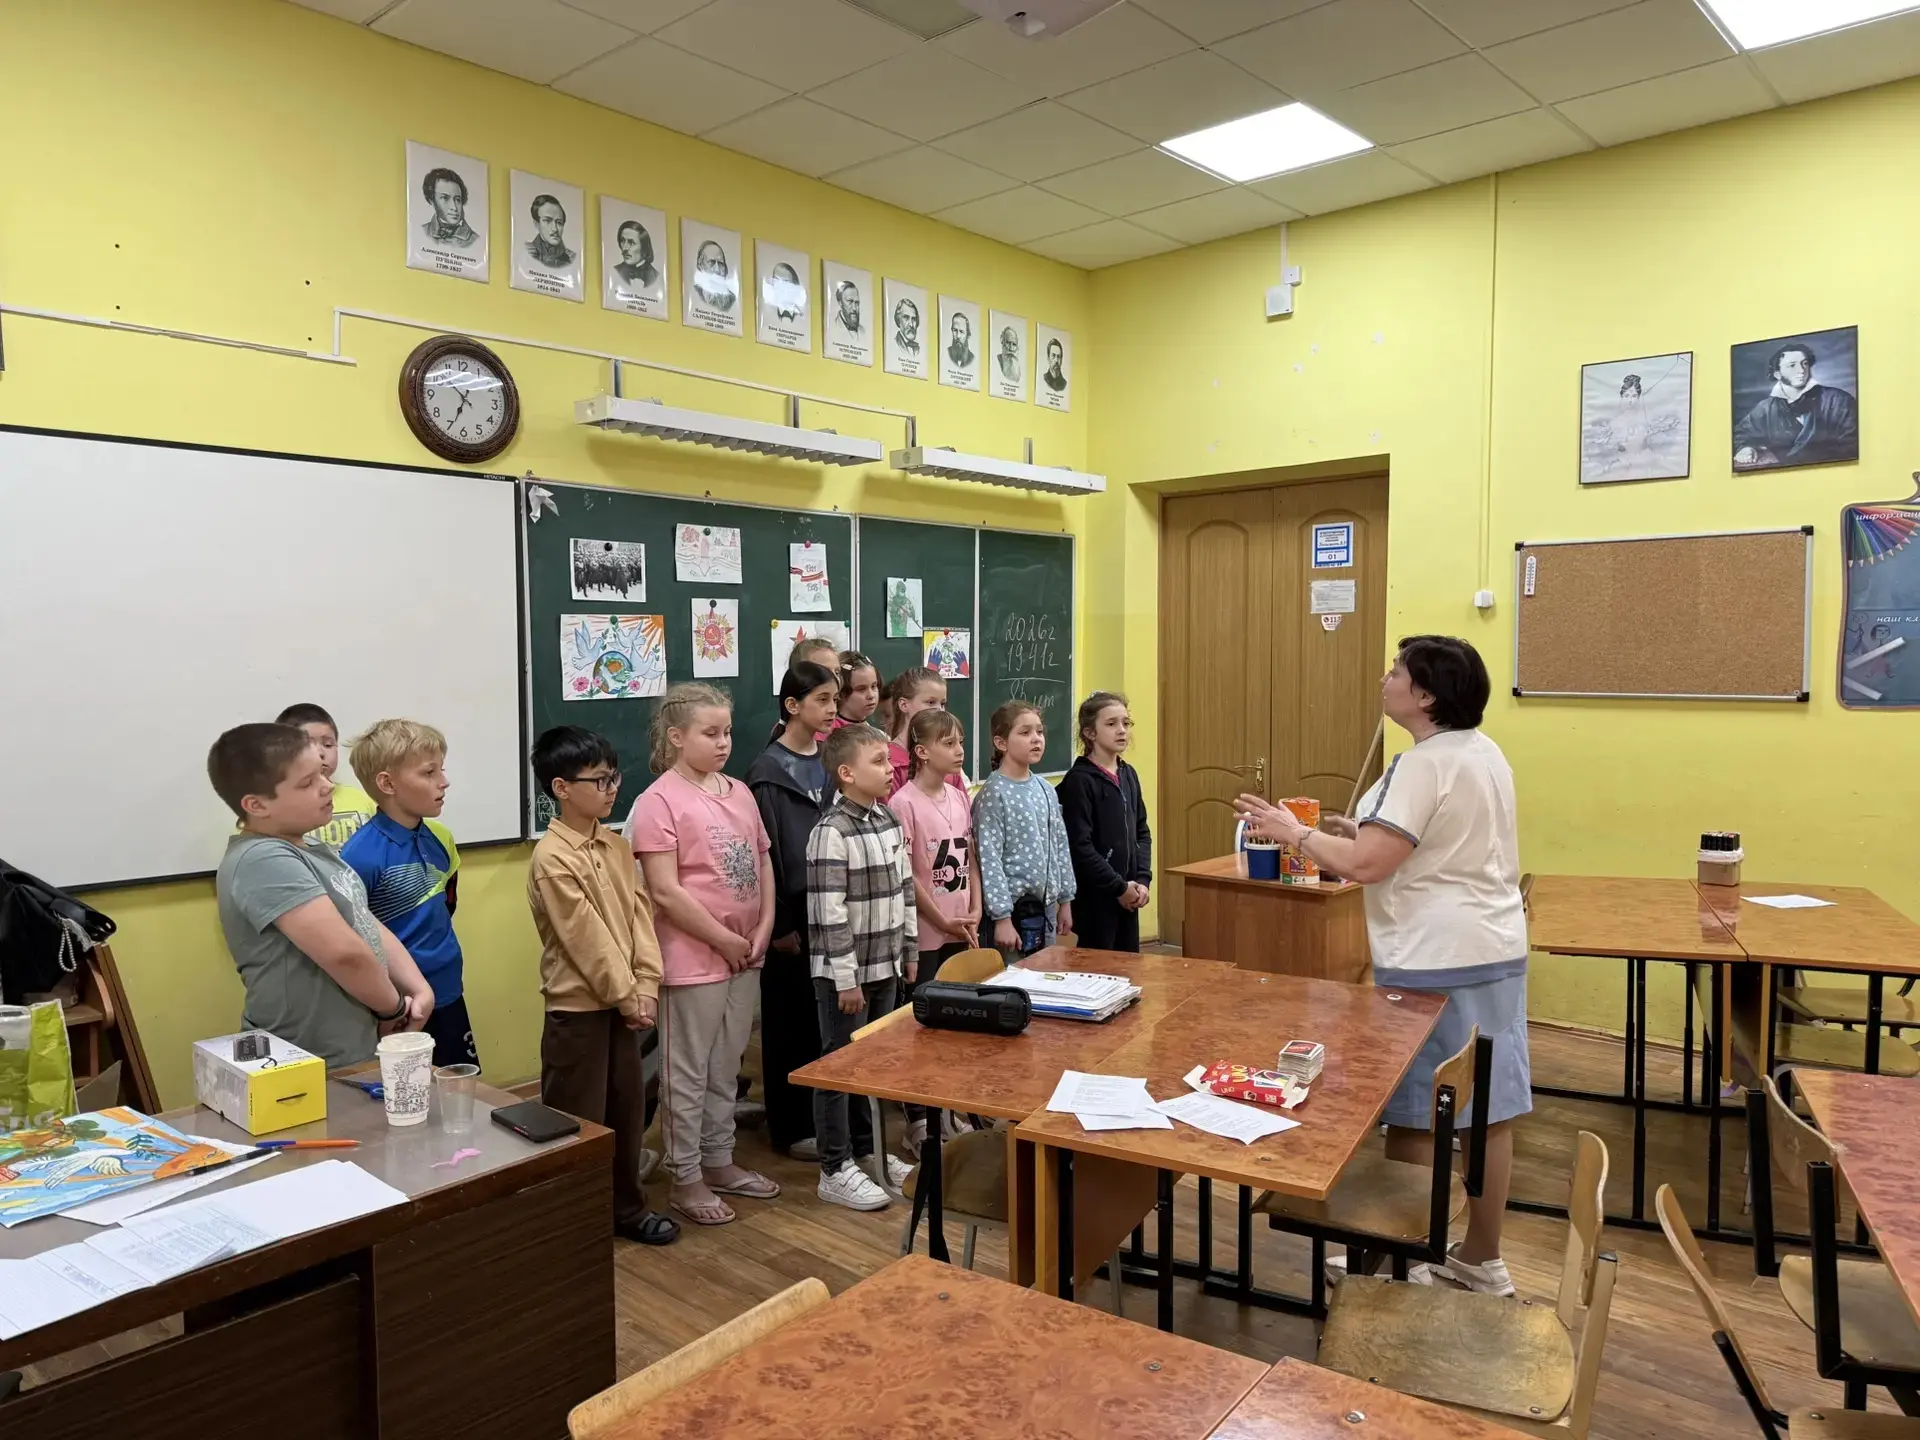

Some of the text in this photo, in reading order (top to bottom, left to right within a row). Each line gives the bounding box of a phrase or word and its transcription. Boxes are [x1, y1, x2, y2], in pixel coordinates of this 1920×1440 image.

[435, 255, 463, 267] ПУШКИН
[436, 262, 462, 273] 1799-1837
[457, 361, 469, 372] 12
[427, 389, 435, 400] 9
[491, 399, 499, 411] 3
[433, 407, 441, 418] 8
[446, 420, 454, 431] 7
[486, 415, 494, 426] 4
[459, 426, 468, 438] 6
[475, 424, 483, 436] 5
[932, 870, 948, 880] SIX
[941, 1005, 988, 1019] AWEI
[1230, 1064, 1248, 1083] UNO
[1220, 1086, 1235, 1094] UNO
